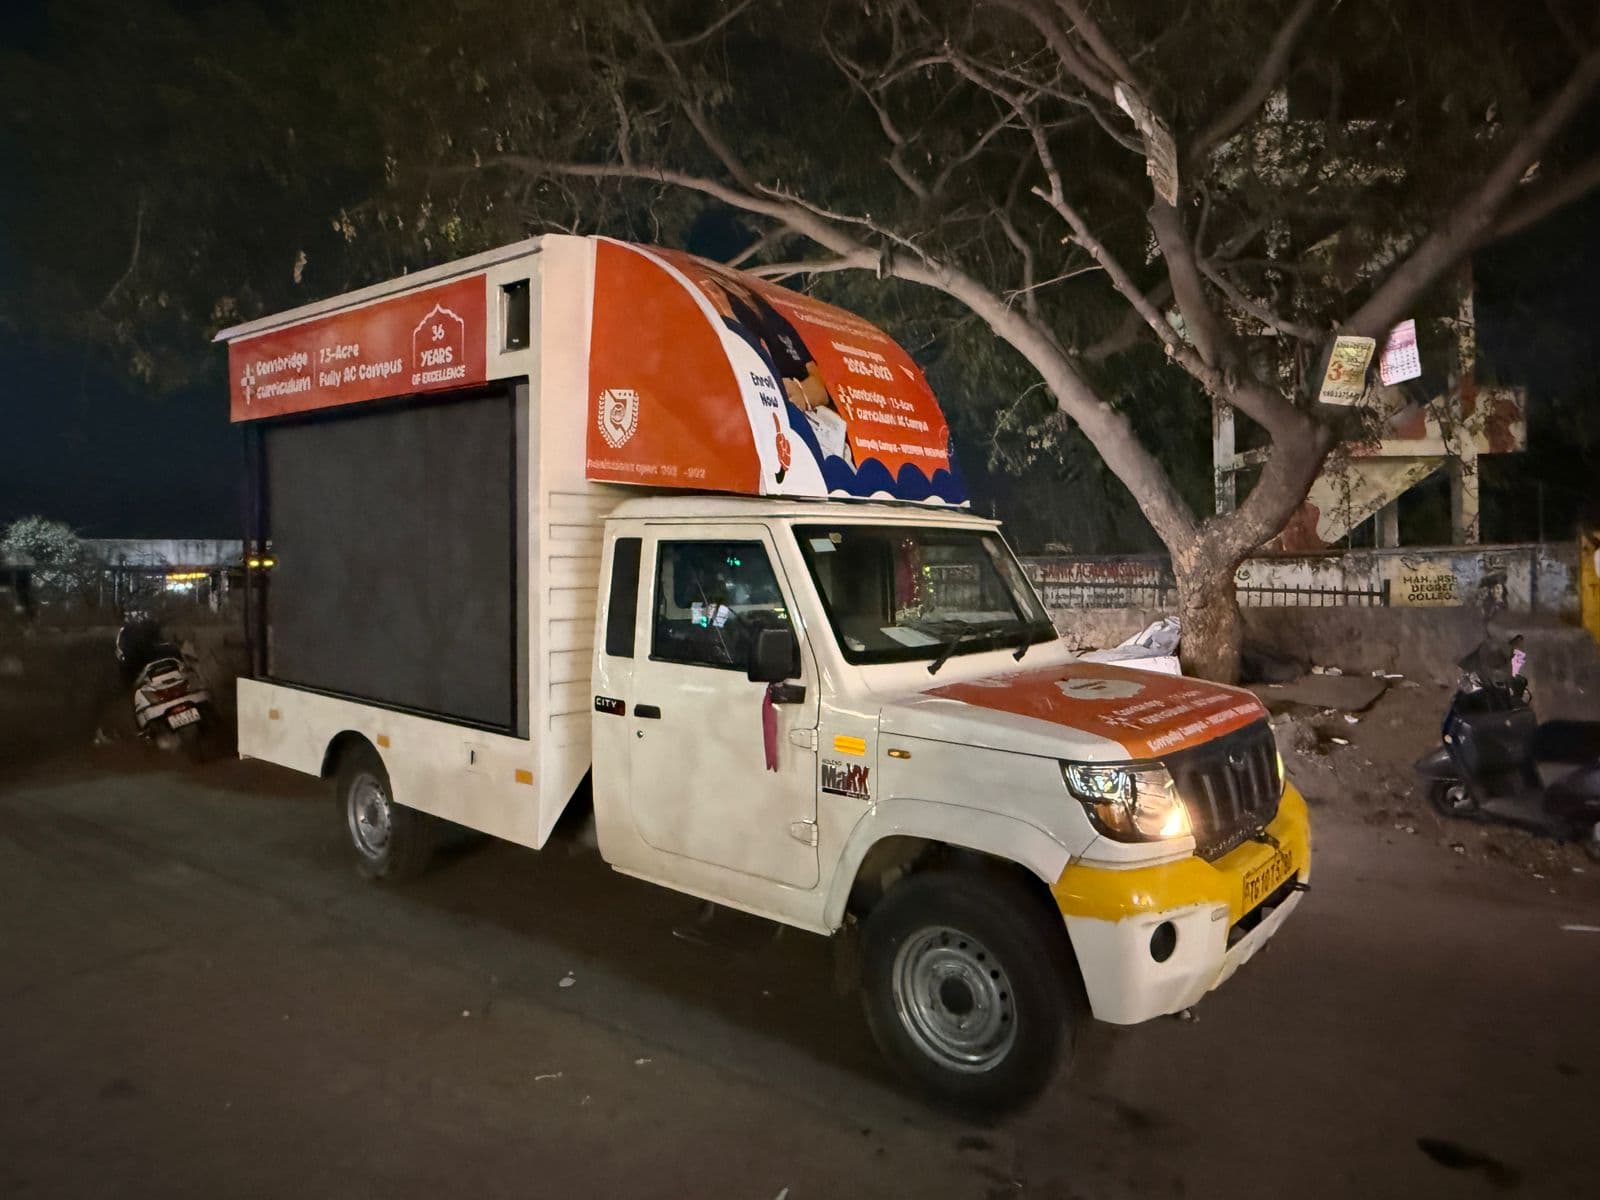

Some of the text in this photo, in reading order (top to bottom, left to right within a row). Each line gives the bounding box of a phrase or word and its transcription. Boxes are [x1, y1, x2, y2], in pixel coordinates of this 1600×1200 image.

[431, 323, 445, 341] 36
[420, 345, 453, 367] YEARS
[343, 365, 357, 383] AC
[359, 358, 403, 380] Campus
[411, 364, 466, 385] OF EXCELLENCE
[750, 371, 776, 390] Enroll
[759, 391, 779, 408] Now
[596, 697, 617, 708] CITY
